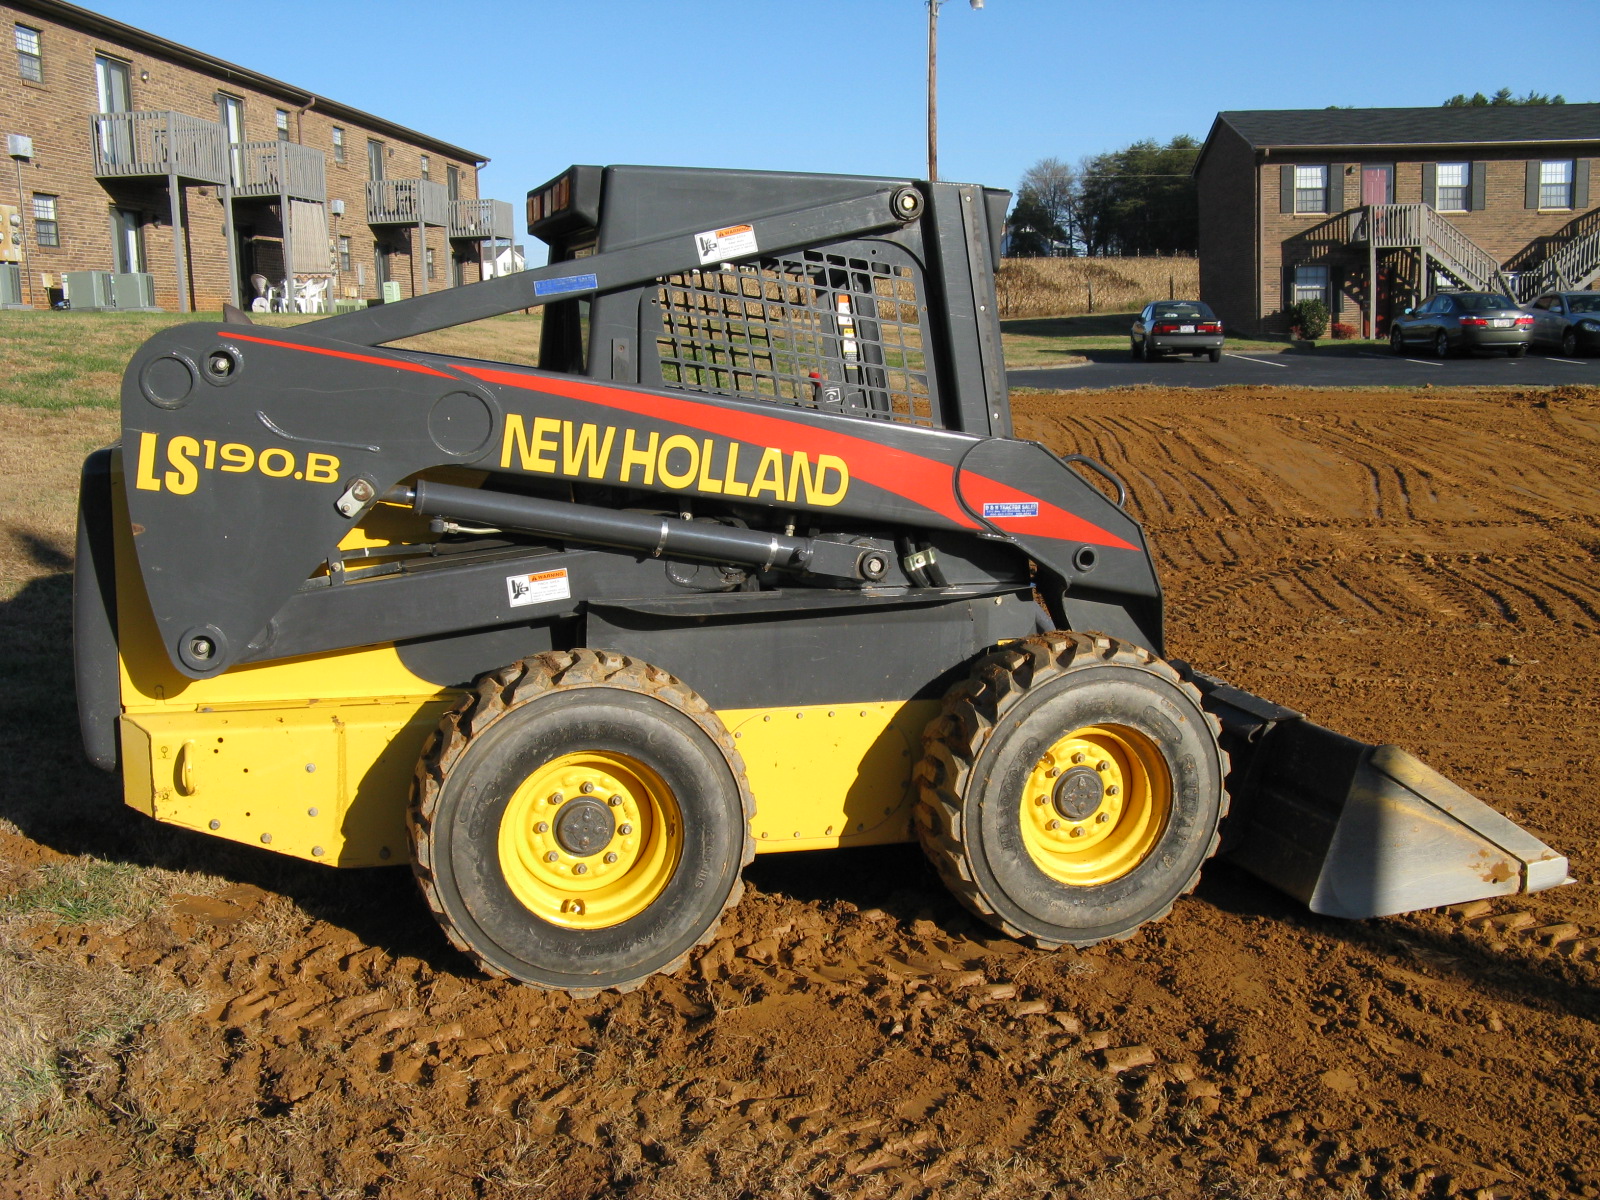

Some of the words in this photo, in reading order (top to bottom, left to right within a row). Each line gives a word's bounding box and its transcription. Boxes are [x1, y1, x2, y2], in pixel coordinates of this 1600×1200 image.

[725, 227, 749, 235] WARNING
[501, 413, 617, 480] NEW
[620, 428, 850, 507] HOLLAND
[538, 571, 564, 580] WARNING
